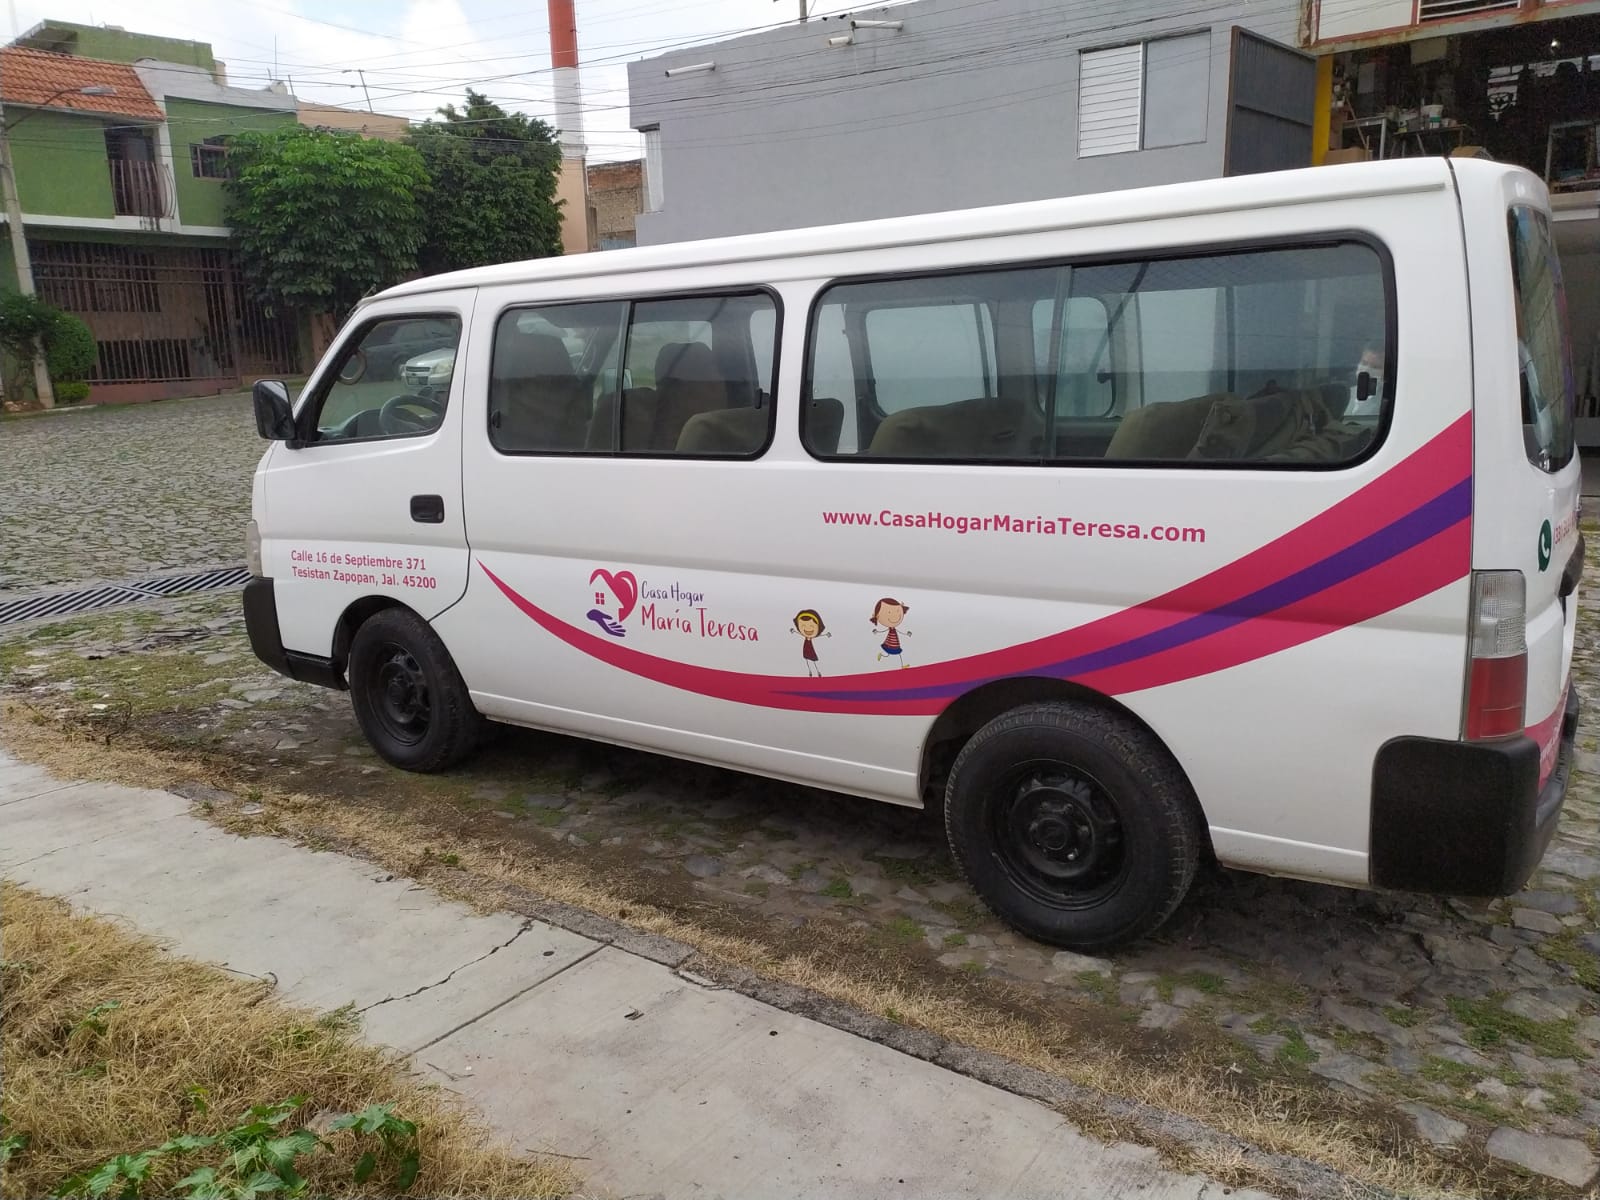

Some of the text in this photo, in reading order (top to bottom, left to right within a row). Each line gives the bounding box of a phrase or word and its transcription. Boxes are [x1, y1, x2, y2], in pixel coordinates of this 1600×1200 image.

[823, 510, 1206, 543] www.CasaHogarMariaTeresa.com
[291, 550, 426, 570] Calle 16 de Septiembre 371
[292, 566, 436, 589] Tesistan Zapopan, Jal. 45200
[641, 580, 704, 607] Casa Hogar
[641, 603, 759, 641] María Teresa
